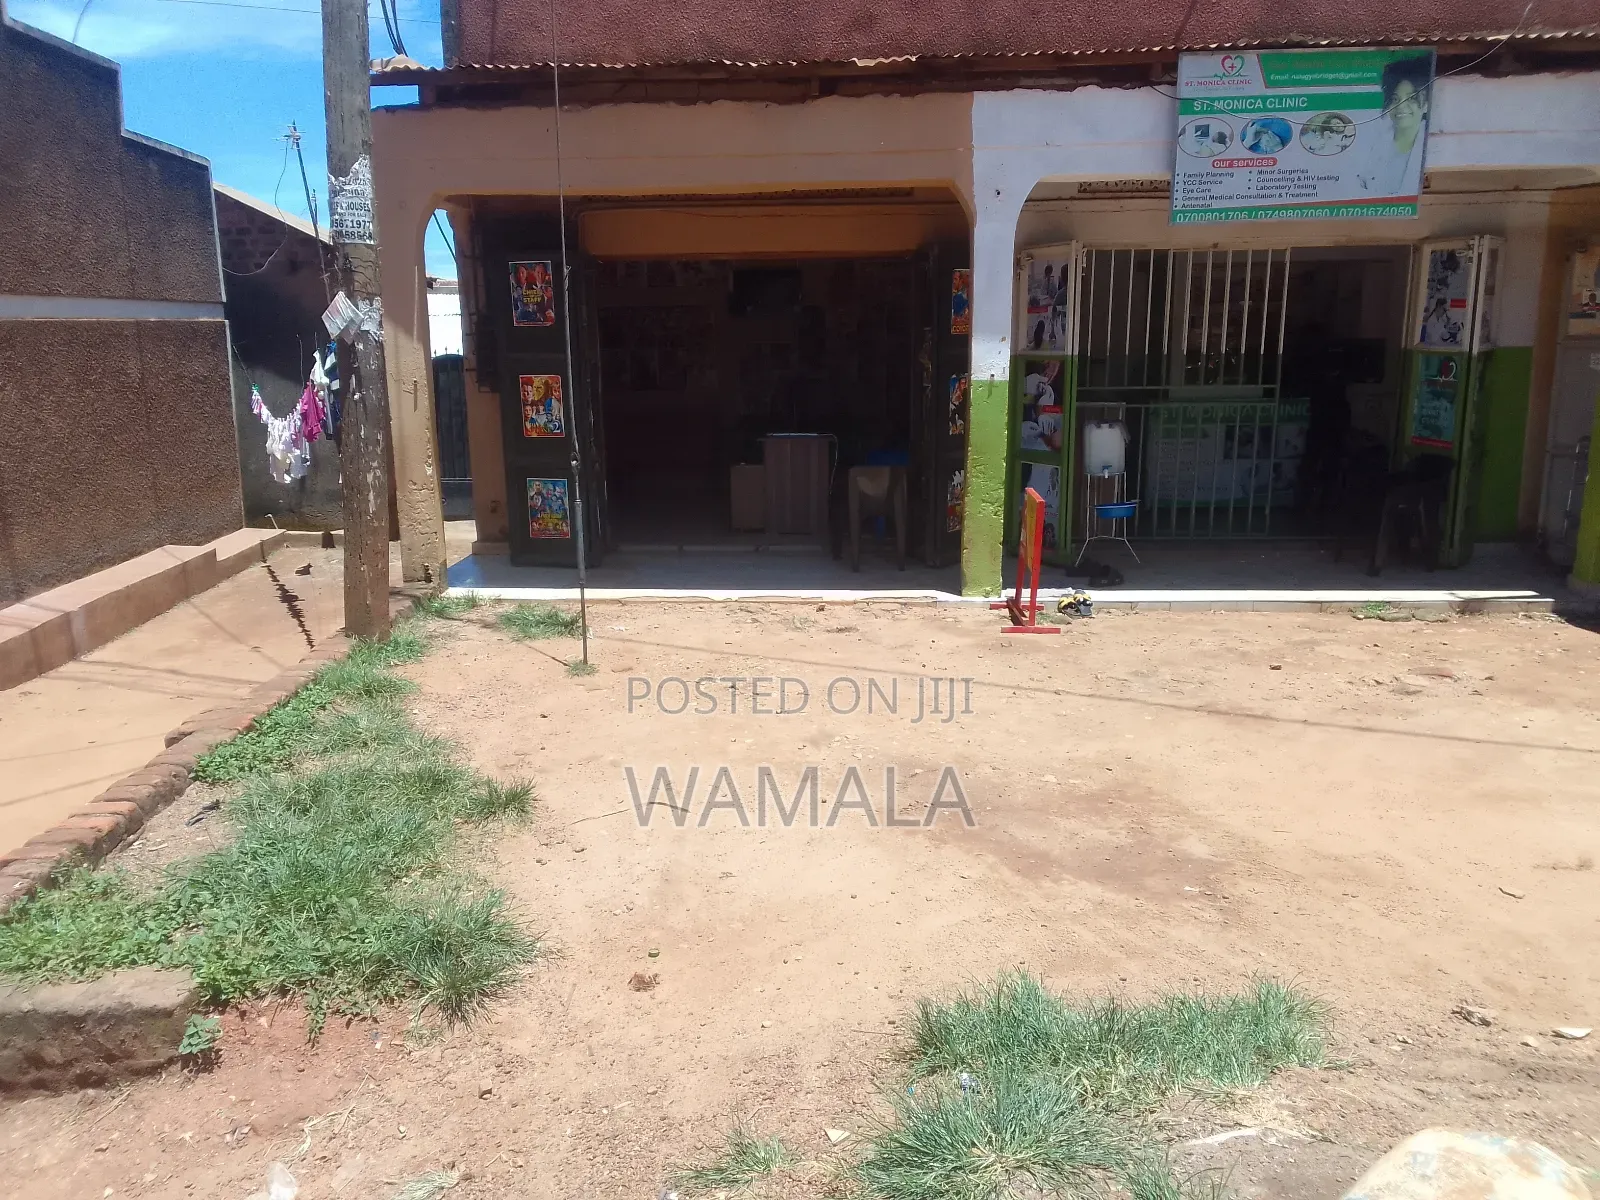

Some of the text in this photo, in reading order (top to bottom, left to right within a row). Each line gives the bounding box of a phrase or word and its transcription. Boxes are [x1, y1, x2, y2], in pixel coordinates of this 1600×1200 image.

[1194, 97, 1308, 111] ST. MONICA CLINIC
[1214, 158, 1274, 168] our services
[1206, 171, 1235, 179] Planning
[1317, 174, 1340, 182] testing
[1293, 183, 1317, 191] Testing
[1285, 191, 1318, 199] Treatment
[345, 201, 371, 212] HOUSES
[1339, 206, 1412, 217] 0701674050
[552, 421, 561, 433] 2
